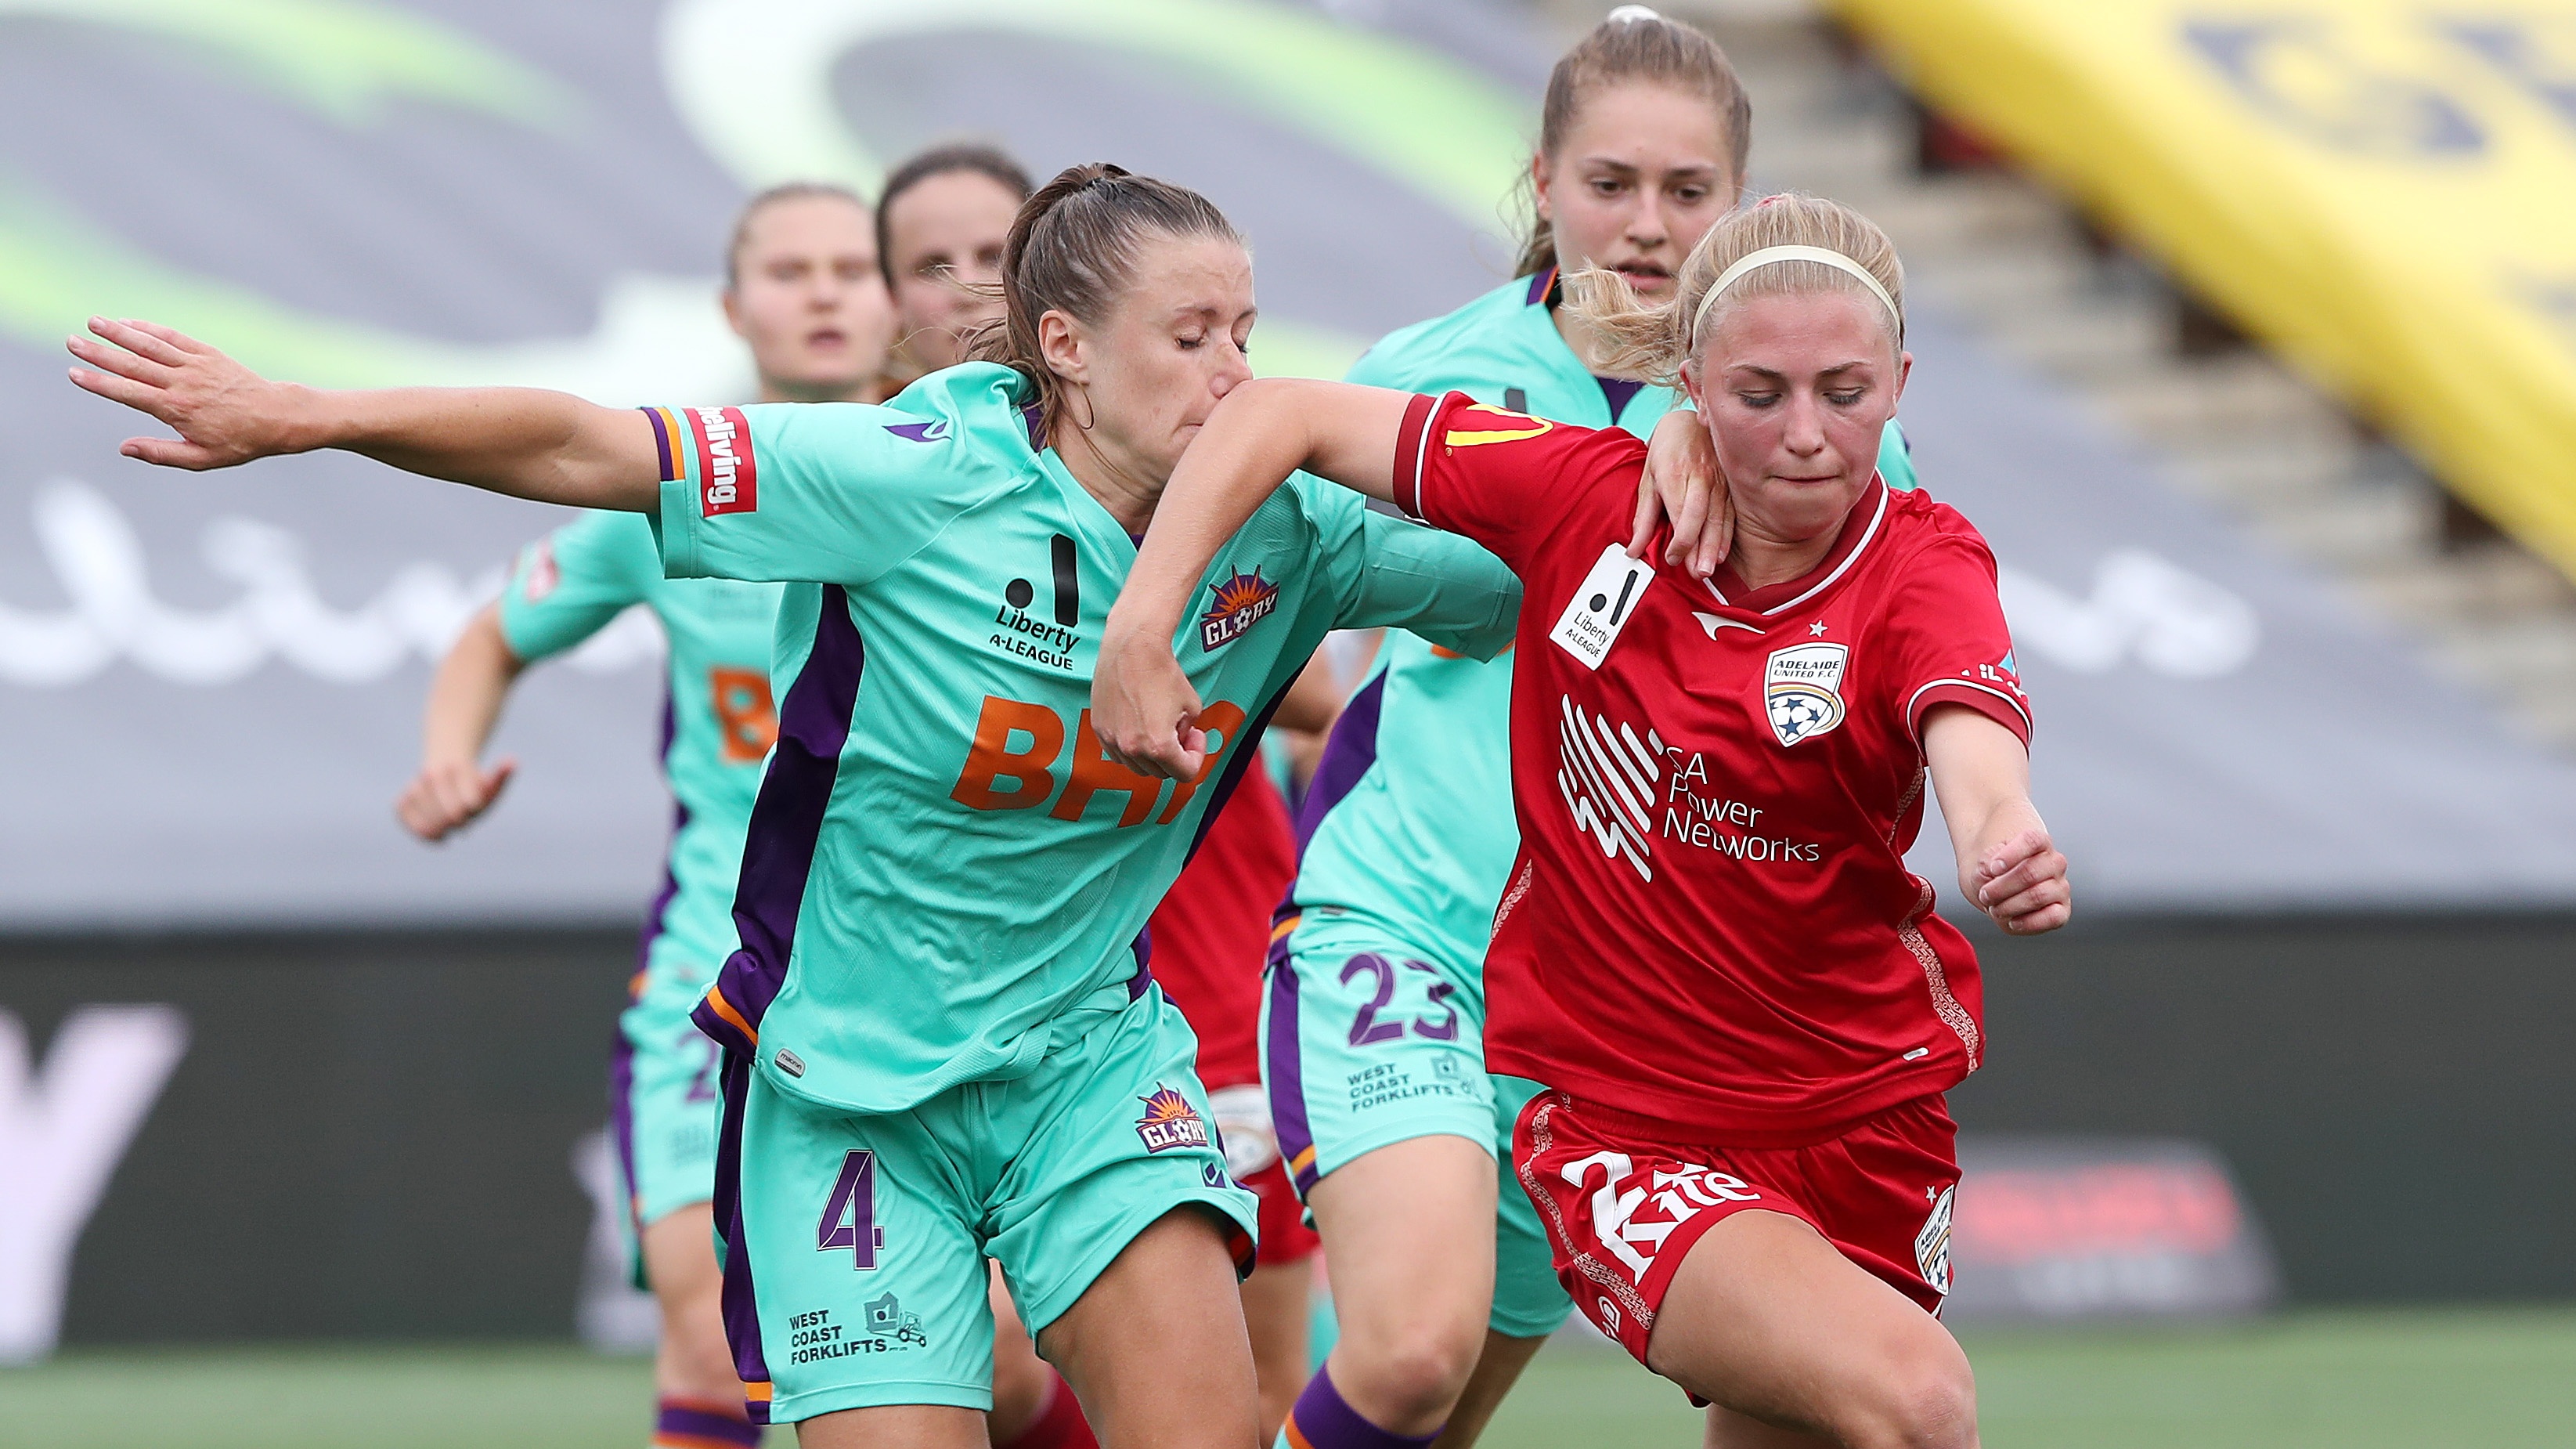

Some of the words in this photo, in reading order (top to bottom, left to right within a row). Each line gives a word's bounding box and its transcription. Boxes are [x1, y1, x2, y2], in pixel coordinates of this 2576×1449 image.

[995, 605, 1081, 654] Liberty
[1206, 592, 1278, 645] GLORY
[1574, 611, 1610, 646] Liberty
[989, 634, 1073, 670] A-LEAGUE
[1565, 628, 1601, 658] A-LEAGUE
[1773, 670, 1814, 678] UNITED
[1774, 660, 1840, 670] ADELAIDE
[1666, 746, 1708, 784] SA
[1669, 772, 1763, 828] Power
[1663, 807, 1820, 862] Networks
[1338, 951, 1459, 1048] 23
[1347, 1063, 1397, 1086] WEST
[1350, 1074, 1411, 1099] COAST
[1351, 1084, 1454, 1113] FORKLIFTS
[817, 1149, 884, 1270] 4
[789, 1309, 829, 1330] WEST
[791, 1339, 886, 1365] FORKLIFTS
[792, 1325, 842, 1347] COAST
